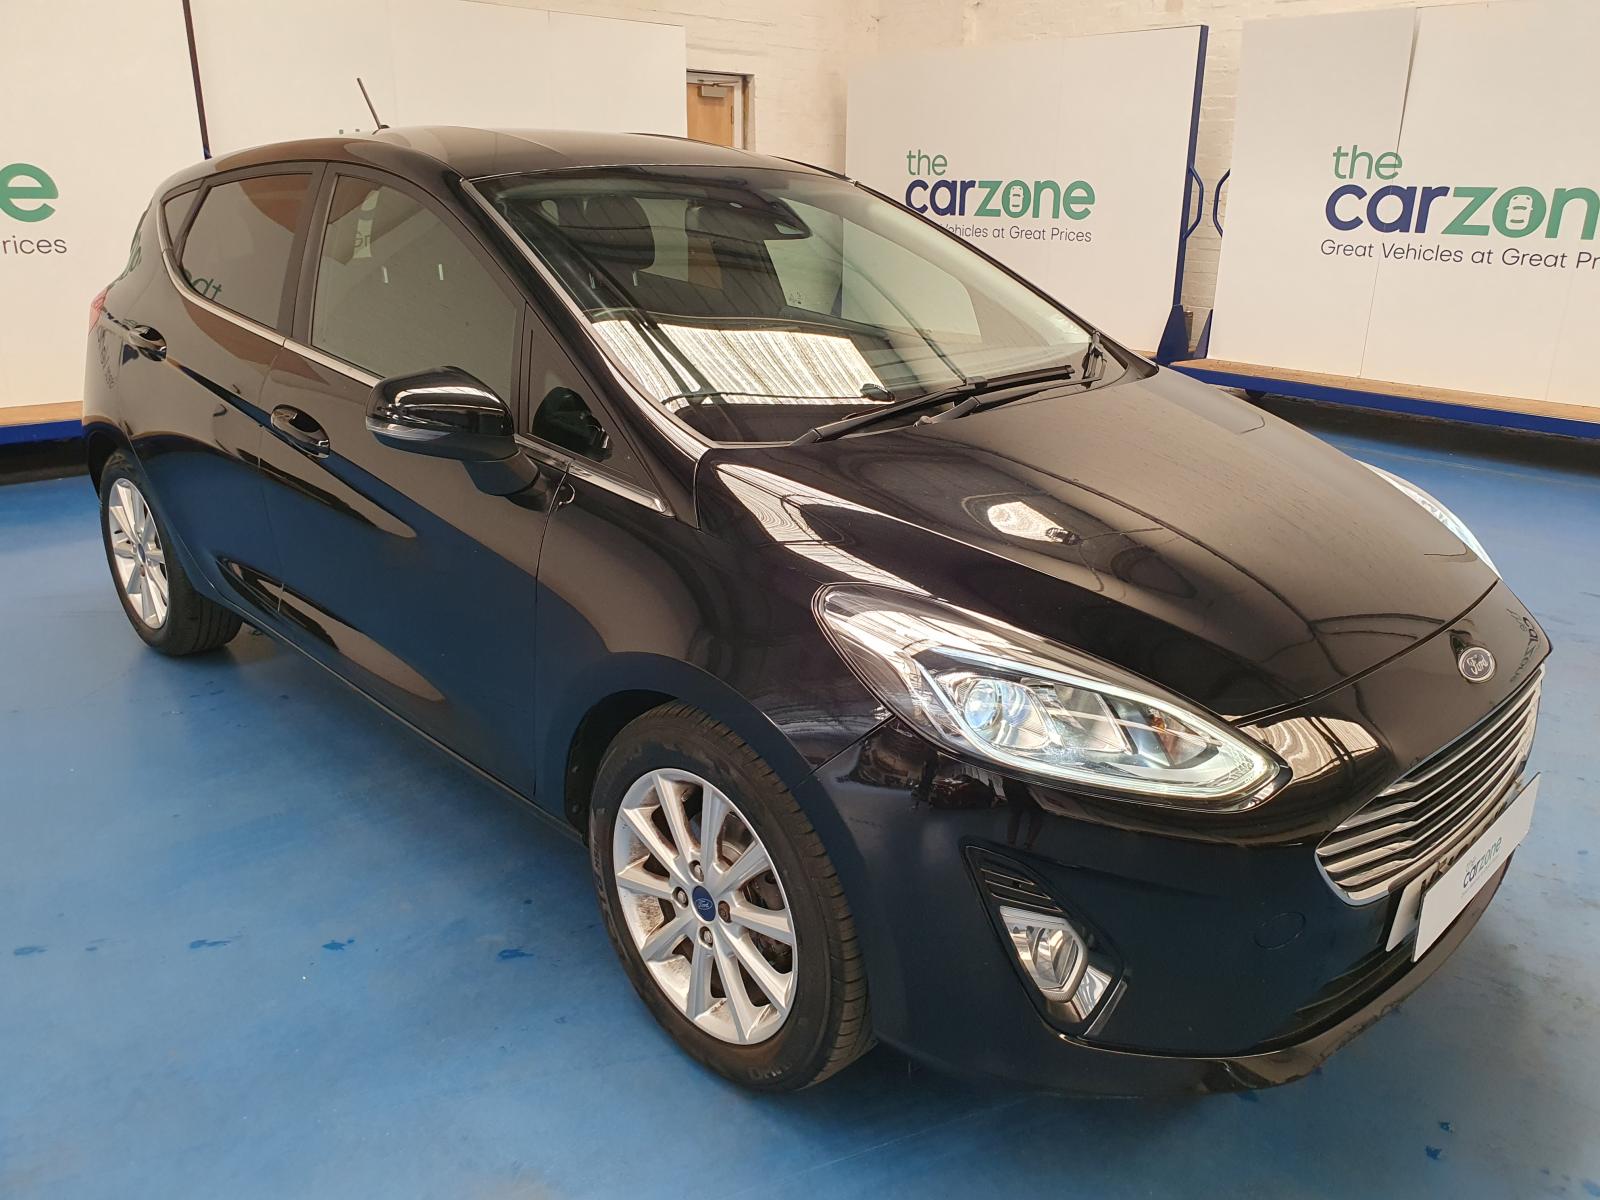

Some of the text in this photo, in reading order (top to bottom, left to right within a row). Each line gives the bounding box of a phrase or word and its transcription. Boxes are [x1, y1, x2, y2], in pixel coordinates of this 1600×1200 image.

[906, 149, 948, 176] the
[1332, 145, 1403, 180] the
[905, 179, 1096, 220] carzone
[992, 227, 1005, 239] at
[1009, 225, 1046, 240] Great
[1051, 227, 1092, 243] Prices
[1320, 239, 1374, 258] Great
[1382, 243, 1464, 263] Vehicles
[1471, 249, 1494, 265] at
[1501, 248, 1568, 268] Great
[1466, 654, 1489, 675] Ford
